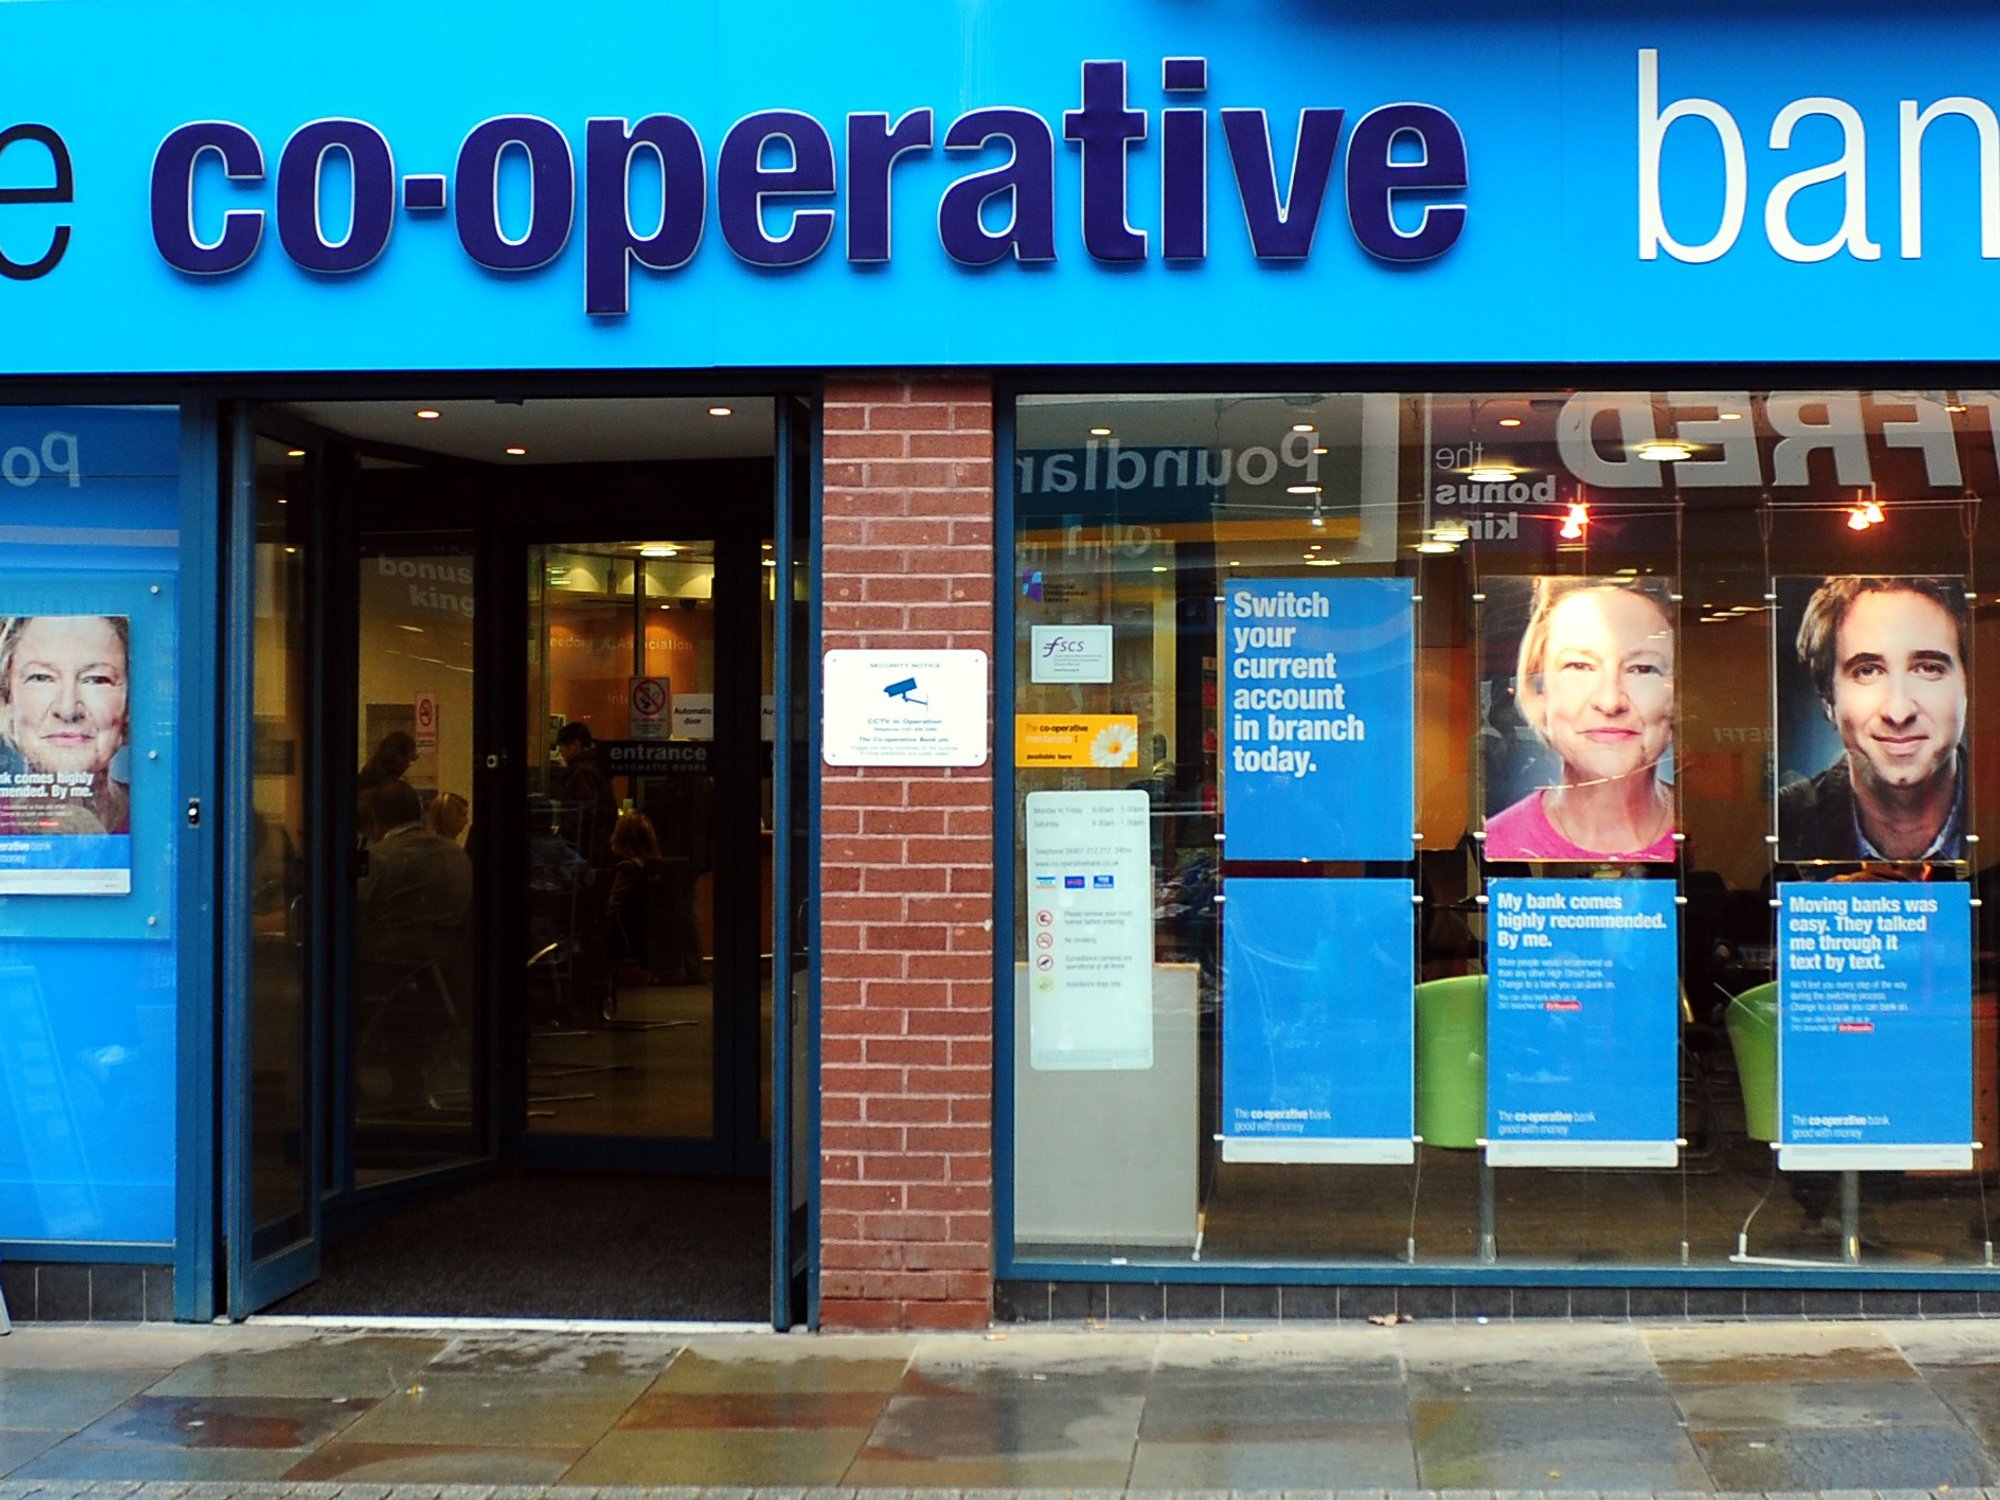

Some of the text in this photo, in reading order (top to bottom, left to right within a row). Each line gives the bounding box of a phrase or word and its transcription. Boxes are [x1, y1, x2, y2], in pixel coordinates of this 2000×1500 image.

[148, 56, 1469, 316] co-operative
[1233, 590, 1330, 618] Switch
[1233, 625, 1297, 654] your
[1233, 652, 1337, 680] current
[1233, 683, 1346, 710] account
[902, 718, 943, 726] Operation
[1039, 723, 1089, 734] co-operative
[1234, 713, 1366, 741] in branch
[610, 743, 706, 761] entrance
[1232, 744, 1318, 779] today.
[14, 773, 54, 785] comes
[57, 771, 94, 787] highly
[50, 785, 68, 800] By
[70, 787, 94, 798] me.
[1497, 893, 1623, 913] My bank comes
[1789, 896, 1938, 916] Moving banks was
[1497, 912, 1668, 931] highly recommended.
[1789, 915, 1927, 935] easy. They talked
[1497, 930, 1553, 950] By me.
[1789, 934, 1899, 954] me through it
[1789, 953, 1886, 973] text by text.
[1235, 1107, 1332, 1121] The co-operative bank
[1498, 1111, 1597, 1124] The co-operative bank
[1792, 1114, 1890, 1128] The co-operative bank
[1234, 1121, 1305, 1135] good with money
[1498, 1124, 1520, 1136] good
[1540, 1125, 1569, 1136] money
[1792, 1128, 1814, 1140] good
[1833, 1129, 1862, 1140] money
